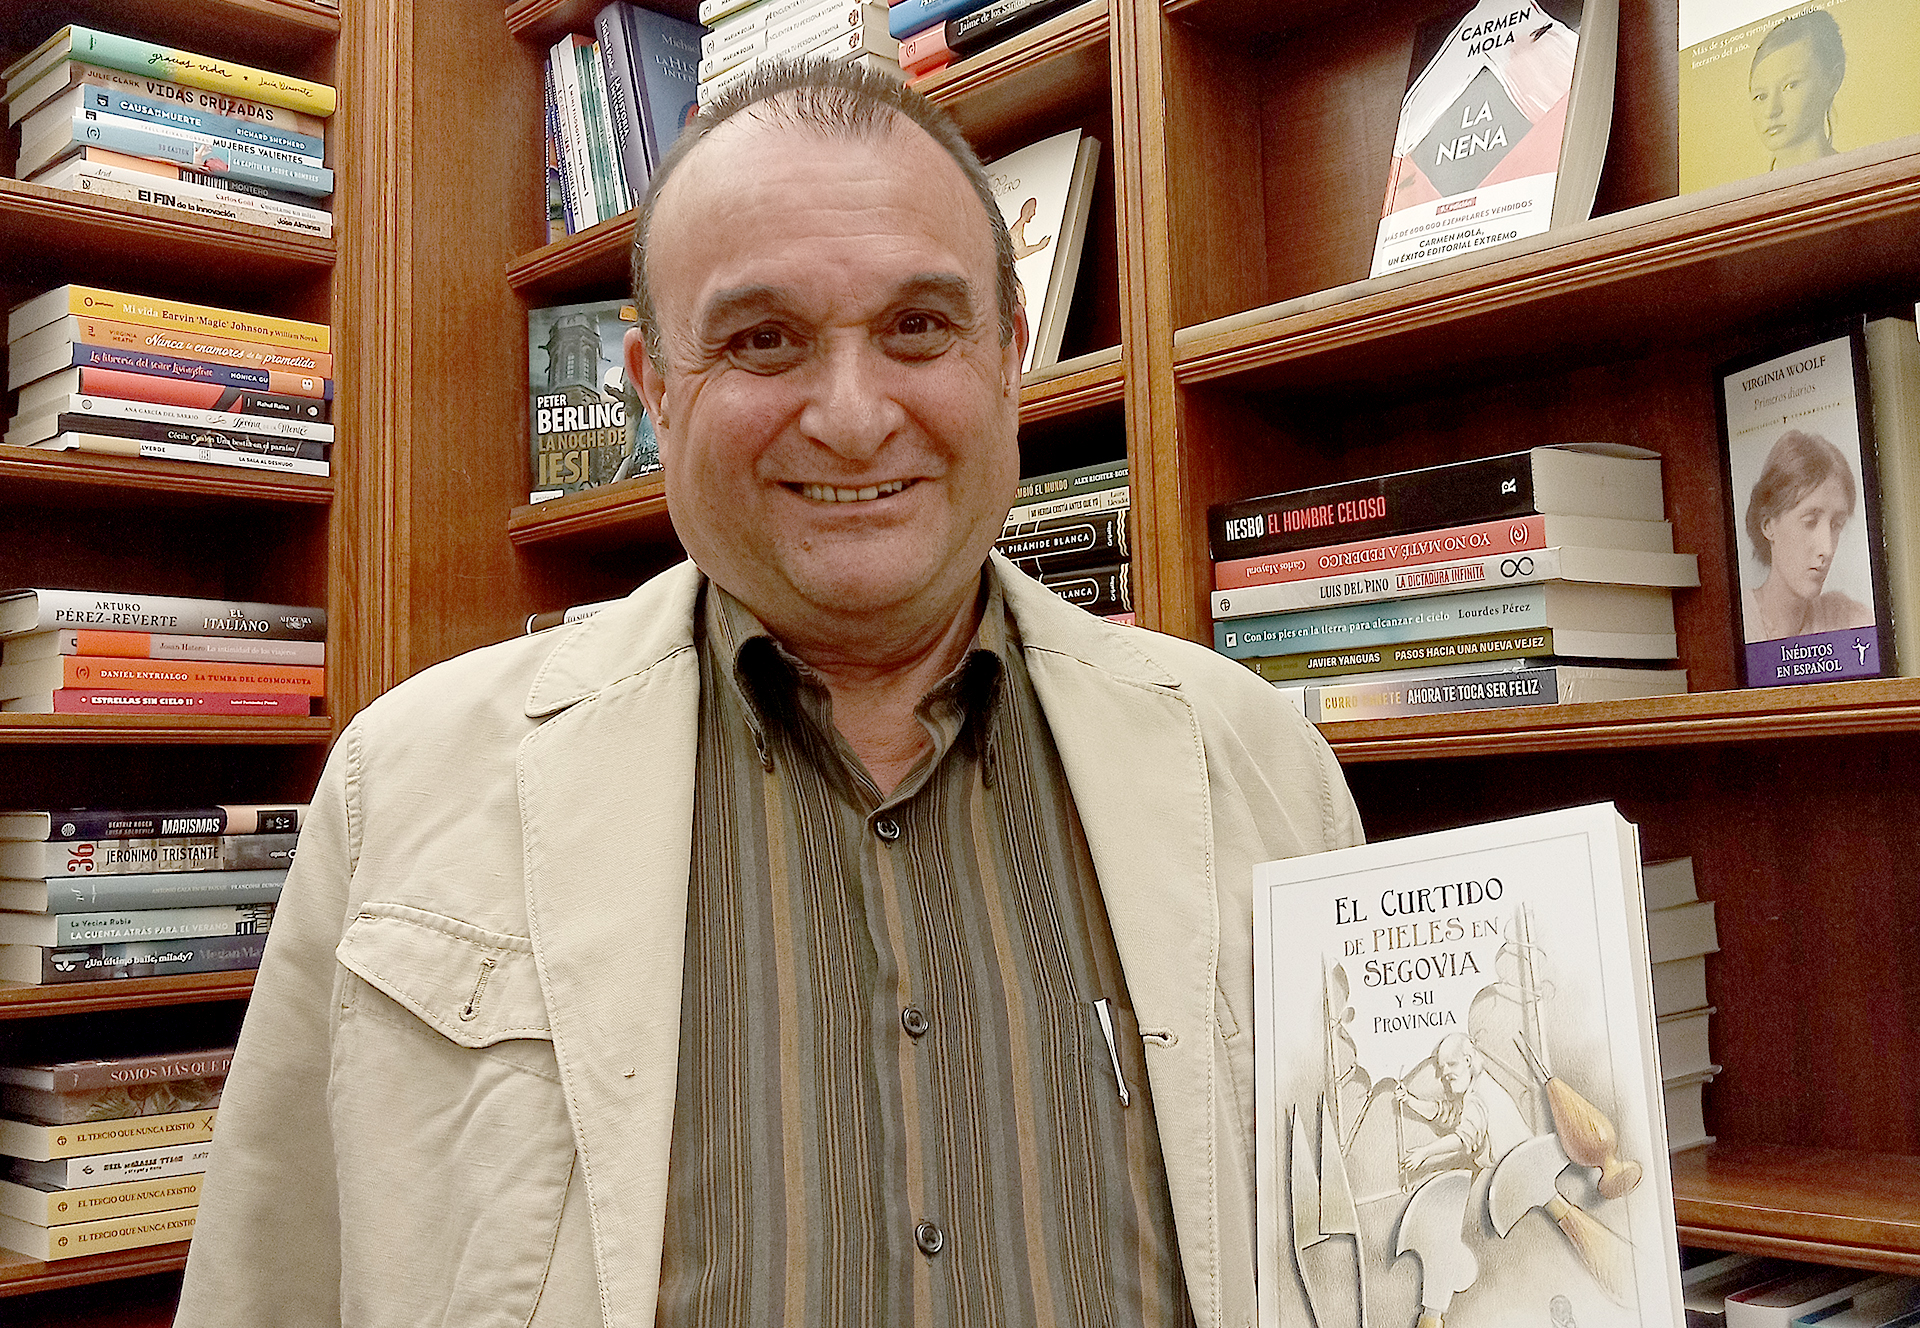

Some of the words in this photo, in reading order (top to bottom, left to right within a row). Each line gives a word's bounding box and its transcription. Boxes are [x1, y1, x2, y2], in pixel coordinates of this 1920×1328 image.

[958, 17, 980, 36] Jaime
[981, 12, 990, 23] de
[990, 9, 1001, 19] los
[1461, 7, 1532, 42] CARMEN
[1467, 31, 1516, 57] MOLA
[1692, 48, 1708, 57] Más
[1710, 42, 1718, 50] de
[1746, 18, 1786, 37] ejemplares
[148, 53, 196, 69] gracias
[200, 64, 232, 77] vida
[1691, 55, 1720, 69] literario
[1721, 48, 1733, 57] del
[87, 70, 110, 81] JULIE
[112, 76, 140, 88] CLARK
[146, 82, 194, 104] VIDAS
[200, 94, 274, 121] CRUZADAS
[617, 88, 630, 137] HISTORIA
[120, 101, 154, 116] CAUSA
[162, 110, 202, 127] MUERTE
[1460, 99, 1494, 130] LA
[212, 139, 256, 155] MUJERES
[258, 148, 303, 164] VALIENTES
[1435, 125, 1508, 166] NENA
[230, 182, 269, 197] MONTERO
[138, 190, 151, 203] El
[153, 192, 176, 208] FIN
[196, 205, 236, 219] Innovación
[1388, 257, 1400, 266] UN
[1401, 250, 1425, 263] ÉXITO
[1427, 241, 1472, 257] EDITORIAL
[1474, 230, 1518, 246] EXTREMO
[1419, 234, 1455, 248] CARMEN
[1456, 228, 1485, 240] MOLA,
[123, 304, 136, 312] Mi
[137, 306, 159, 317] vida
[162, 311, 195, 323] Earvin
[231, 321, 269, 335] Johnson
[275, 330, 299, 340] William
[1742, 369, 1785, 392] VIRGINIA
[1786, 355, 1826, 377] WOOLF
[537, 394, 568, 409] PETER
[1754, 396, 1787, 411] Primeros
[1787, 383, 1816, 400] diarios
[537, 402, 626, 434] BERLING
[539, 435, 556, 452] LA
[558, 430, 605, 450] NOCHE
[607, 428, 626, 446] DE
[1501, 478, 1516, 495] R
[1267, 514, 1281, 535] EL
[1283, 504, 1335, 532] HOMBRE
[1337, 495, 1386, 524] CELOSO
[1225, 514, 1265, 542] NESBØ
[1008, 539, 1050, 554] PIRÁMIDE
[1053, 533, 1090, 546] BLANCA
[1402, 539, 1441, 560] MATÉ
[1444, 535, 1466, 551] NO
[1470, 532, 1491, 547] YO
[1318, 547, 1386, 570] FEDERICO
[1388, 546, 1399, 559] A
[1246, 562, 1279, 577] Mayoral
[1280, 560, 1307, 571] Carlos
[1320, 584, 1341, 599] LUIS
[1344, 580, 1363, 596] DEL
[1365, 577, 1389, 594] PINO
[1396, 576, 1406, 589] LA
[1408, 571, 1449, 587] DICTADURA
[1451, 565, 1485, 583] INFINITA
[56, 608, 178, 627] PÉREZ-REVERTE
[95, 601, 141, 612] ARTURO
[230, 609, 244, 618] EL
[1458, 606, 1500, 619] Lourdes
[1502, 602, 1531, 615] Pérez
[203, 618, 270, 633] ITALIANO
[1243, 632, 1262, 643] Con
[1263, 630, 1277, 641] los
[1278, 628, 1296, 641] pies
[1298, 628, 1309, 637] en
[1311, 625, 1320, 635] la
[1321, 623, 1347, 634] tierra
[1350, 621, 1371, 633] para
[1372, 616, 1413, 629] alcanzar
[1415, 613, 1424, 624] el
[1426, 611, 1450, 623] cielo
[1394, 648, 1425, 661] PASOS
[1426, 645, 1456, 658] HACIA
[1457, 644, 1479, 655] UNA
[1479, 640, 1513, 653] NUEVA
[1514, 636, 1545, 649] VEJEZ
[1780, 643, 1833, 662] INÉDITOS
[1307, 656, 1337, 669] JAVIER
[1338, 652, 1381, 666] YANGUAS
[1776, 665, 1790, 678] EN
[1793, 658, 1842, 676] ESPAÑOL
[100, 670, 135, 679] DANIEL
[136, 671, 189, 681] ENTRIALGO
[258, 677, 311, 685] COSMONAUTA
[91, 696, 141, 705] ESTRELLAS
[142, 697, 158, 705] SIN
[160, 698, 184, 706] CIELO
[186, 698, 194, 706] II
[1407, 687, 1442, 705] AHORA
[1443, 686, 1457, 701] TE
[1457, 684, 1485, 701] TOCA
[1486, 681, 1508, 698] SER
[1509, 678, 1540, 696] FELIZ
[161, 818, 220, 834] MARISMAS
[163, 847, 219, 861] TRISTANTE
[1335, 896, 1367, 925] EL
[1381, 877, 1504, 917] CURTIDO
[71, 931, 82, 940] LA
[84, 929, 122, 939] CUENTA
[123, 926, 153, 937] ATRÁS
[154, 925, 179, 935] PARA
[180, 924, 191, 933] EL
[192, 922, 229, 932] VERANO
[81, 919, 108, 927] Vecina
[110, 917, 132, 926] Rubia
[1344, 938, 1365, 957] DE
[1372, 917, 1464, 952] PIELES
[1472, 916, 1498, 939] EN
[1363, 951, 1481, 988] SEGOVIA
[1395, 994, 1405, 1009] Y
[1412, 990, 1434, 1006] SU
[1374, 1010, 1457, 1034] PROVINCIA
[111, 1069, 158, 1082] SOMOS
[160, 1061, 189, 1077] MÁS
[191, 1060, 220, 1076] QUE
[78, 1200, 88, 1208] EL
[89, 1196, 118, 1207] TERCIO
[119, 1193, 135, 1203] QUE
[136, 1190, 166, 1202] NUNCA
